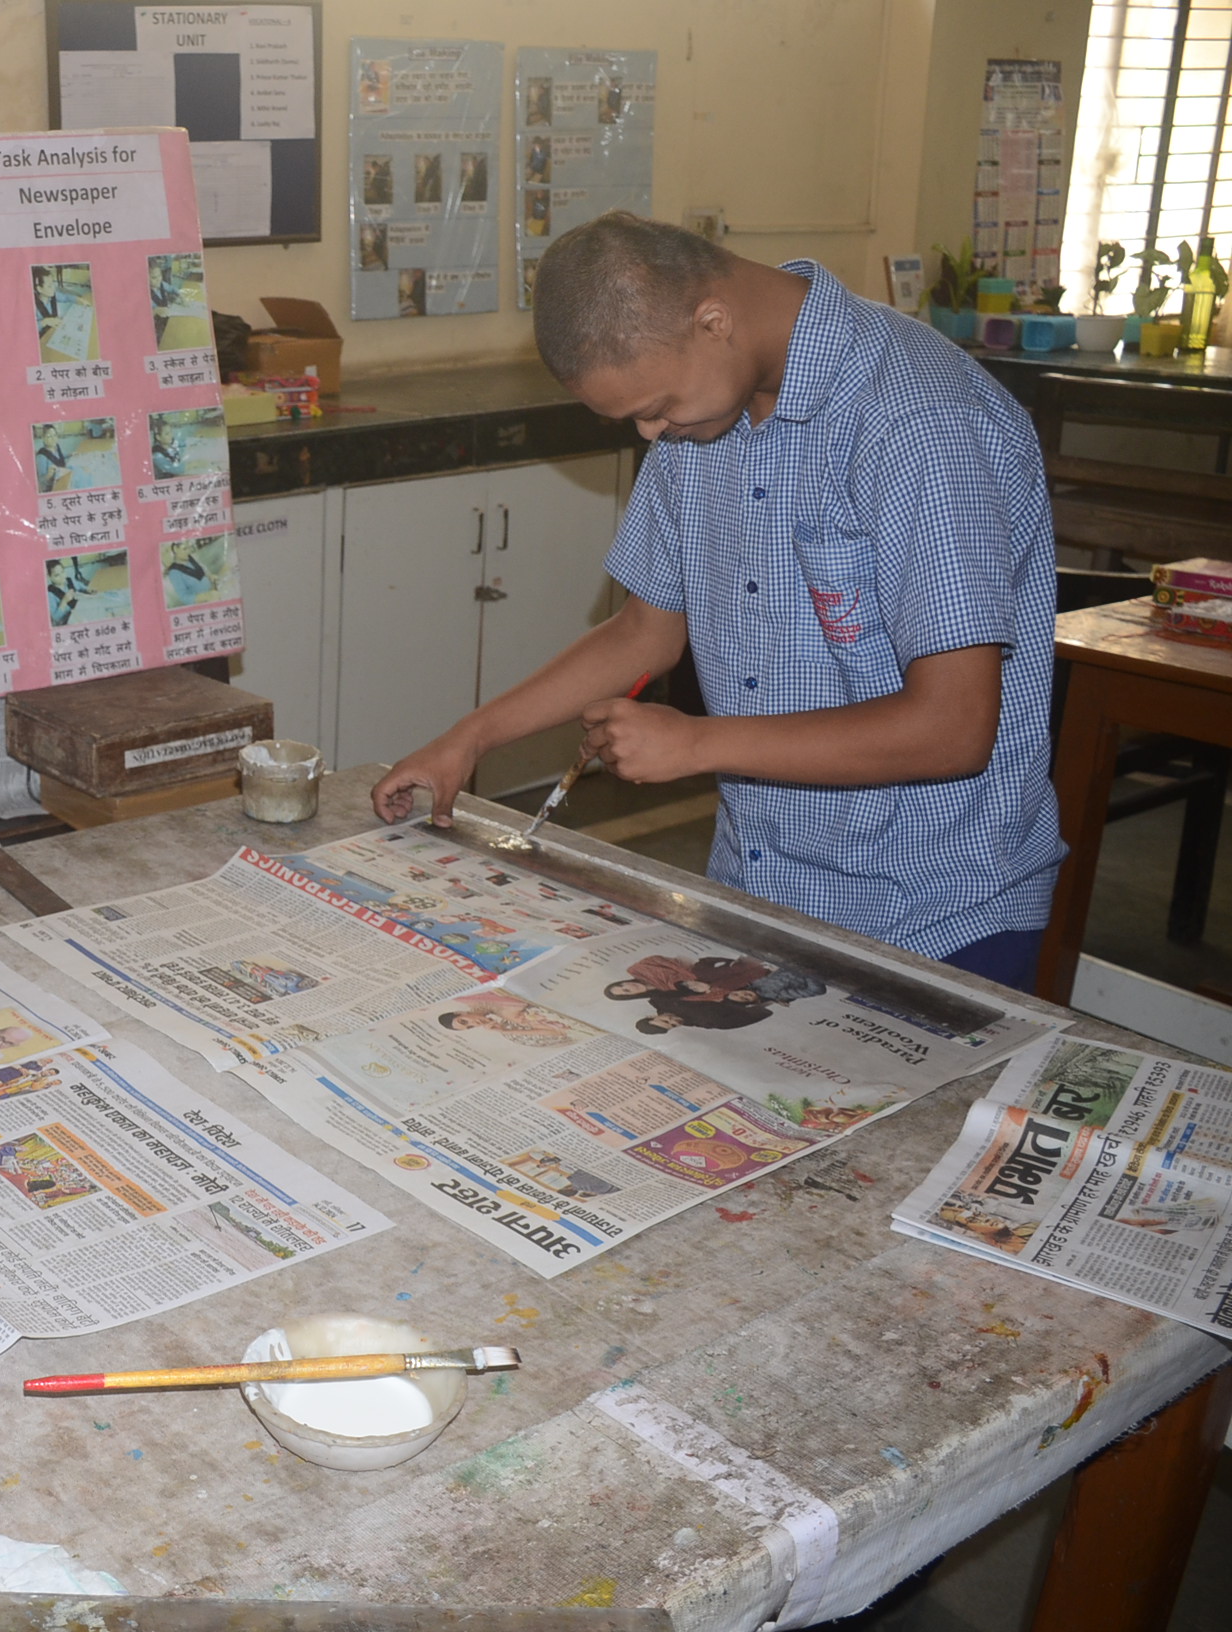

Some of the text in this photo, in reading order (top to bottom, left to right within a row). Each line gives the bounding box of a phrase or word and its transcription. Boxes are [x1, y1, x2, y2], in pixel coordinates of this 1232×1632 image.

[152, 12, 227, 25] STATIONARY
[176, 34, 206, 46] UNIT
[37, 146, 108, 172] Analysis
[112, 145, 137, 165] for
[19, 184, 118, 206] Newspaper
[33, 217, 113, 241] Envelope
[35, 366, 110, 381] 2. पेपर को बीच
[149, 356, 199, 371] 3. स्केल से
[162, 374, 175, 385] को
[47, 386, 56, 399] से
[46, 490, 120, 511] 5. दूसरे पेपर के
[138, 489, 148, 499] 6.
[152, 485, 171, 497] पेपर
[38, 508, 123, 529] नीचे पेपर के टुकड़े
[256, 519, 288, 536] CLOTH
[52, 535, 66, 546] को
[188, 612, 206, 625] पेपर
[210, 609, 219, 620] के
[70, 628, 91, 644] दूसरे
[94, 625, 117, 637] side
[121, 620, 131, 632] के
[173, 631, 192, 643] भाग
[220, 637, 243, 650] करना
[3, 652, 17, 664] पर
[53, 652, 73, 664] पेपर
[78, 647, 90, 659] को
[53, 658, 132, 680] भाग में चिपकाना
[245, 852, 385, 926] ELECTRONICS
[806, 1018, 832, 1030] of
[841, 1013, 931, 1056] Woollens
[841, 1026, 929, 1067] Paradise
[763, 1045, 852, 1089] Christmas
[774, 1059, 816, 1080] Merry
[1143, 1057, 1172, 1090] ₹5393
[1128, 1082, 1156, 1111] शहरी
[179, 1108, 246, 1148] देश-विदेश
[394, 1116, 438, 1139] सचिव
[63, 1082, 229, 1195] महाकुंभ एकता का महायज्ञ मोदी
[460, 1153, 505, 1178] योजना
[983, 1117, 1072, 1206] प्रभात
[496, 1172, 522, 1188] की
[1084, 1165, 1108, 1190] माह
[515, 1182, 556, 1205] विकास
[1077, 1183, 1097, 1202] हर
[548, 1198, 572, 1211] के
[1054, 1191, 1089, 1229] ग्रामीण
[344, 1221, 367, 1233] 17
[430, 1174, 582, 1259] अपना शहर
[563, 1204, 622, 1238] राजधानी
[1047, 1217, 1071, 1238] के
[1028, 1229, 1065, 1270] झारखंड
